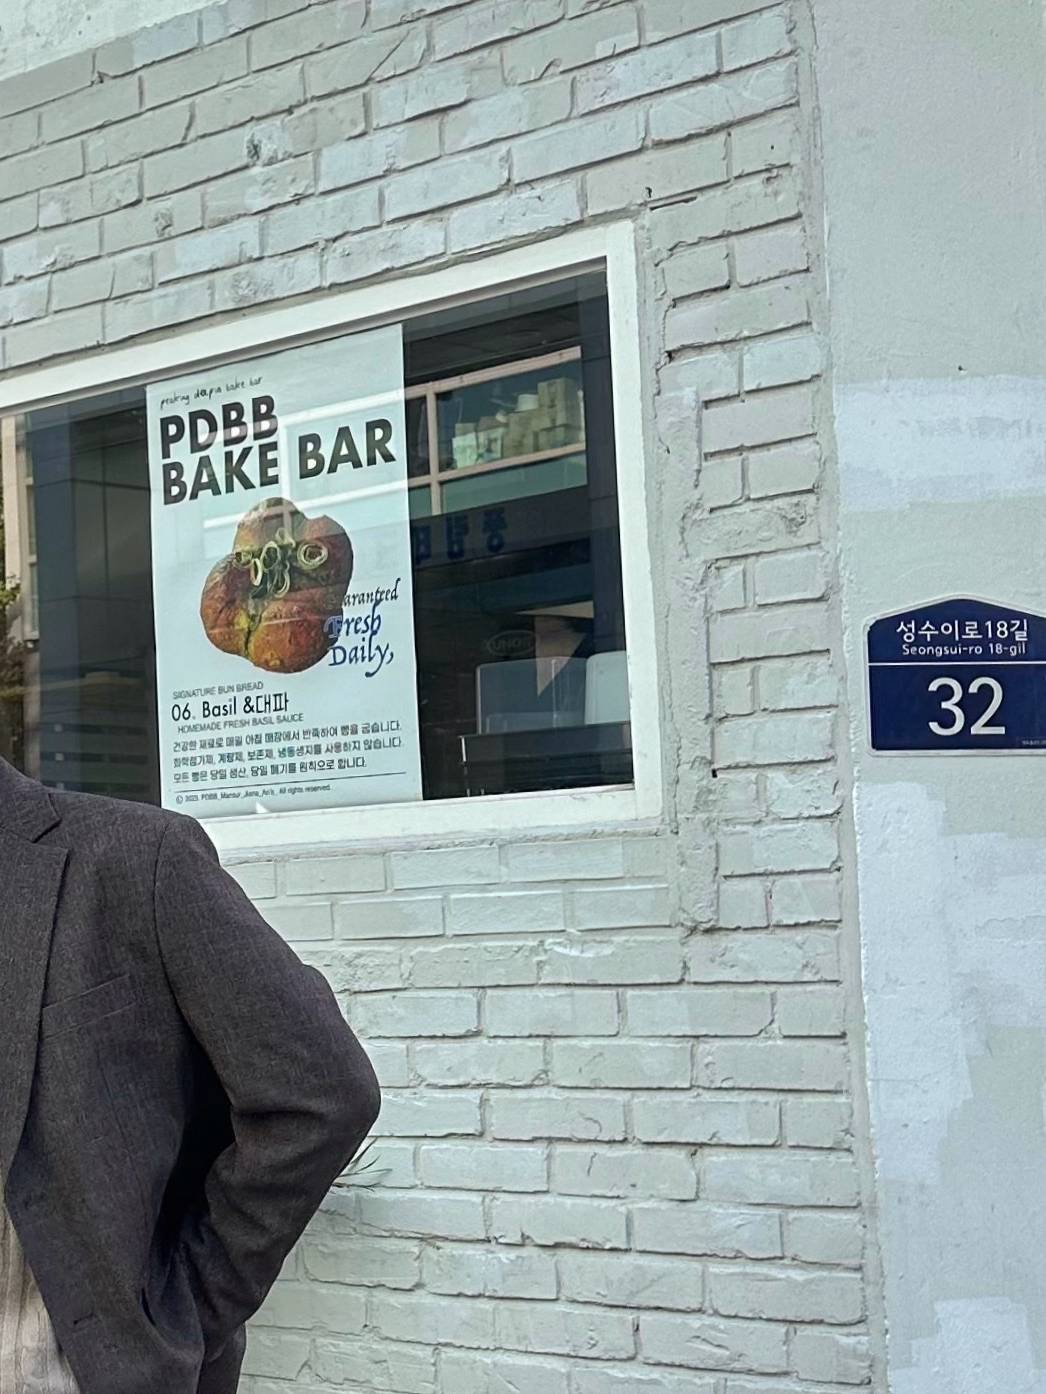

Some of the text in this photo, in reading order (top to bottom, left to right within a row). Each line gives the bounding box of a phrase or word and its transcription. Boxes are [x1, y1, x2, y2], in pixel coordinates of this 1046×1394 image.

[159, 395, 278, 460] PDBB
[162, 418, 396, 506] BAKE BAR
[896, 619, 1029, 643] 성수이로18길
[902, 642, 1026, 657] Seongsui-ro 18-gil
[173, 681, 264, 700] SIGNATURE BUN BREAD
[202, 696, 236, 719] Basil
[928, 676, 1006, 736] 32
[178, 713, 304, 734] HOMEMADE FRESH BASIL SAUCE
